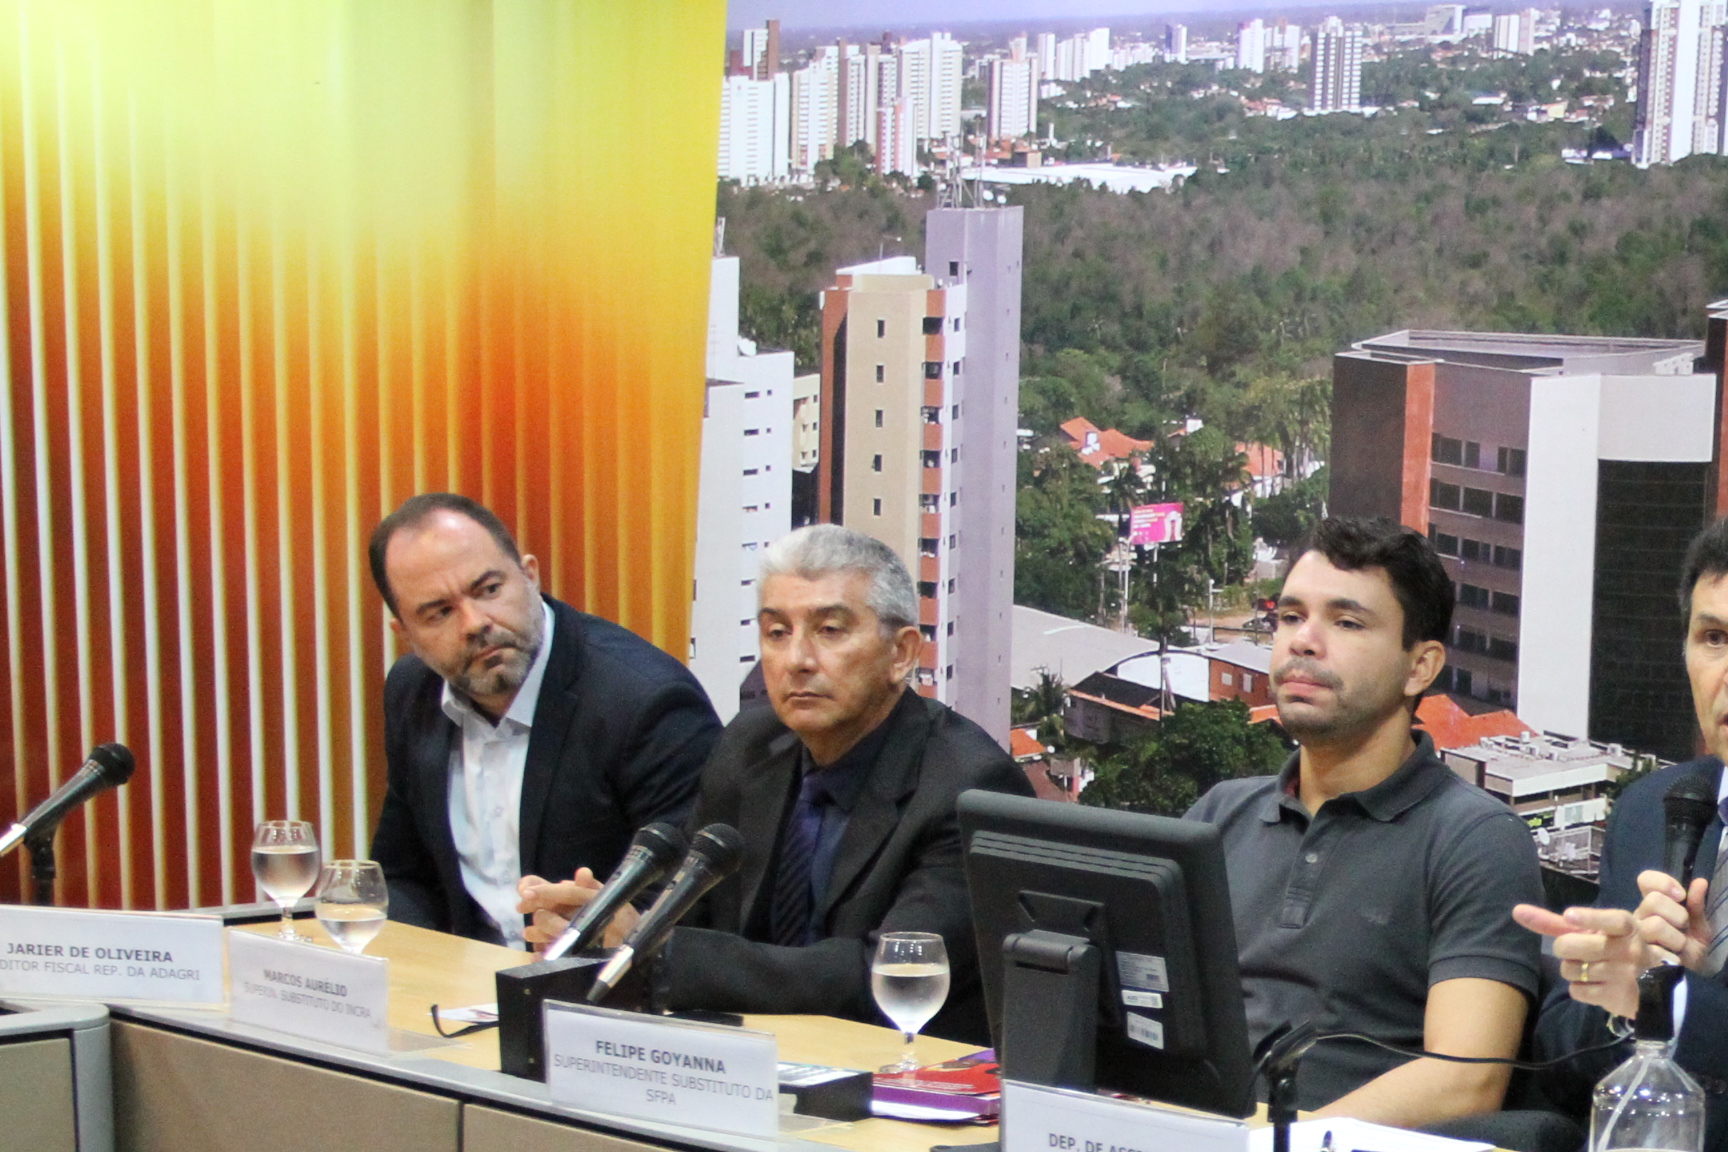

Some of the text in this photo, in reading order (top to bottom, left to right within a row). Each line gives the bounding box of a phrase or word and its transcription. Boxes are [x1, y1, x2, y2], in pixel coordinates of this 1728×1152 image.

[7, 943, 173, 962] JARIER DE OLIVEIRA
[44, 962, 89, 975] FISCAL
[94, 964, 122, 976] REP.
[127, 966, 145, 977] DA
[151, 967, 200, 981] ADAGRI
[263, 969, 302, 988] MARCOS
[596, 1040, 726, 1075] FELIPE GOYANNA
[554, 1054, 774, 1101] SUPERINTENDENTE SUBSTITUTO DA
[646, 1089, 676, 1105] SFPA
[1049, 1133, 1080, 1152] DEP.
